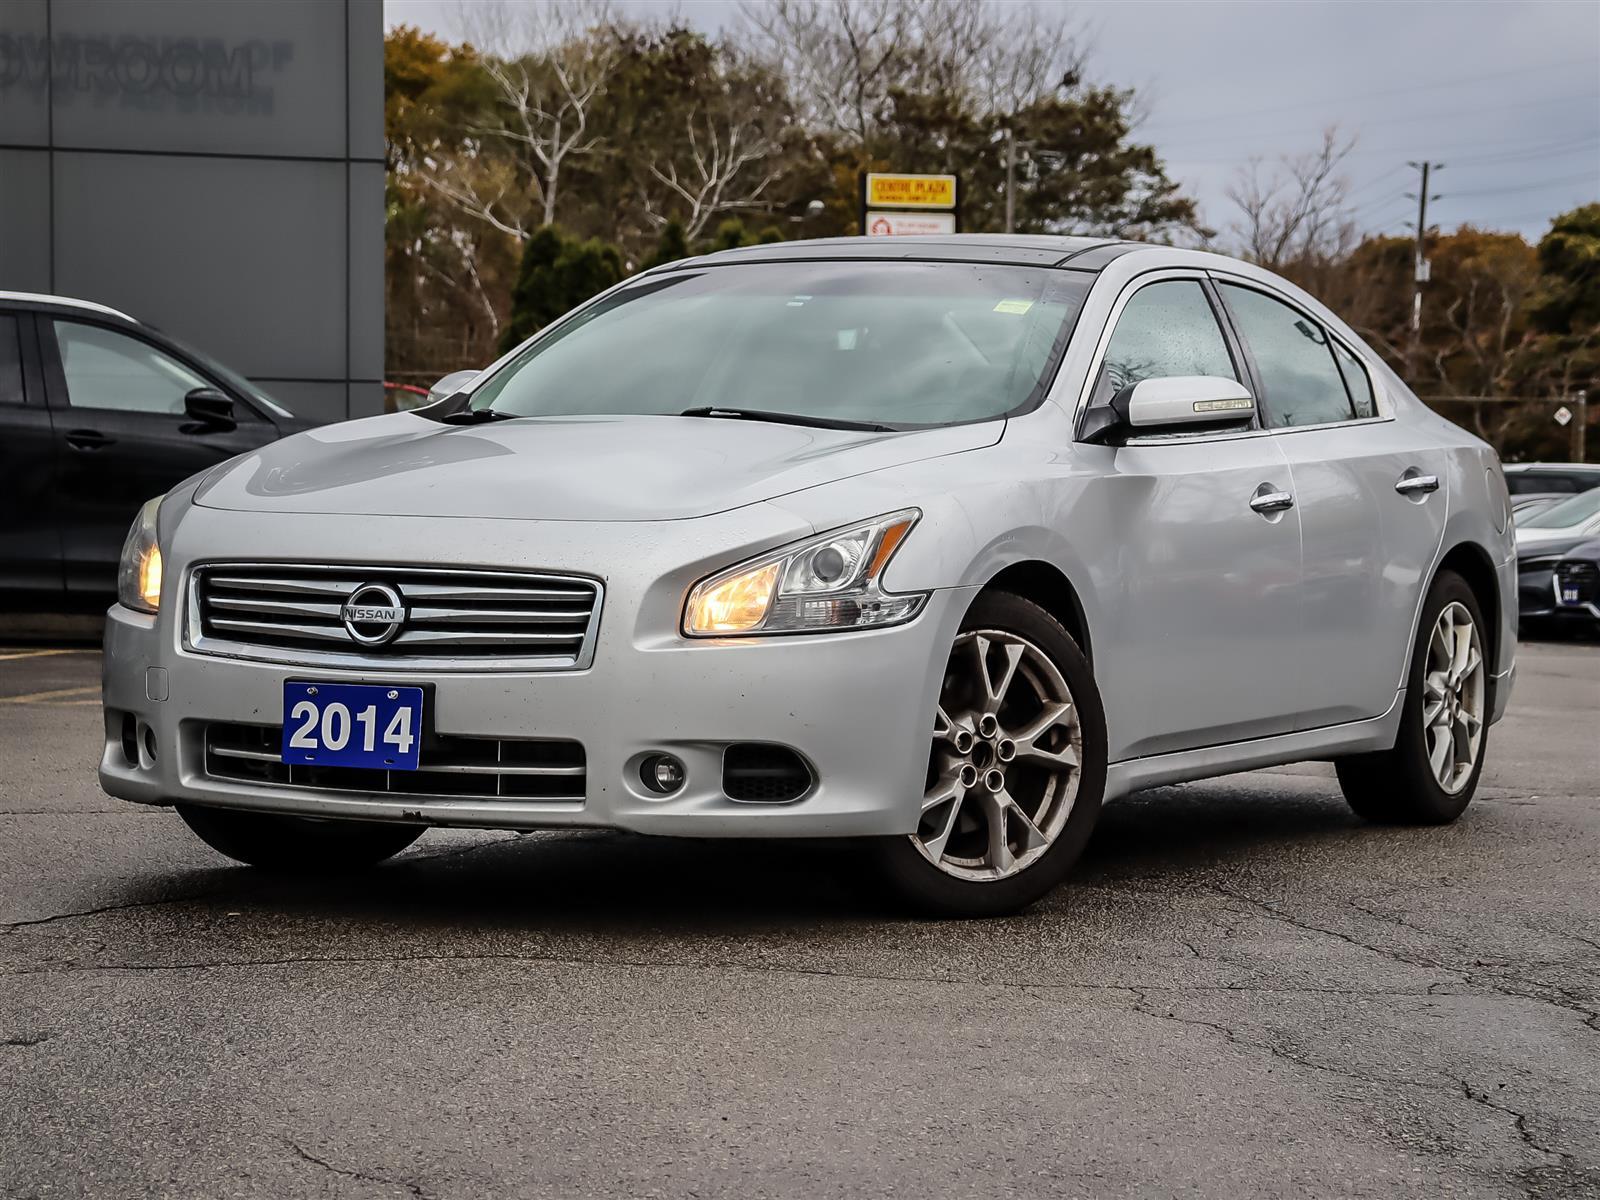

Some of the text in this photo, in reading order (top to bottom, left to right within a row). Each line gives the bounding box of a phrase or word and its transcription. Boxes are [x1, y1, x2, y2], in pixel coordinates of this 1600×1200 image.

[915, 180, 947, 194] PLAZA
[345, 607, 396, 620] NISSAN
[289, 700, 414, 754] 2014
